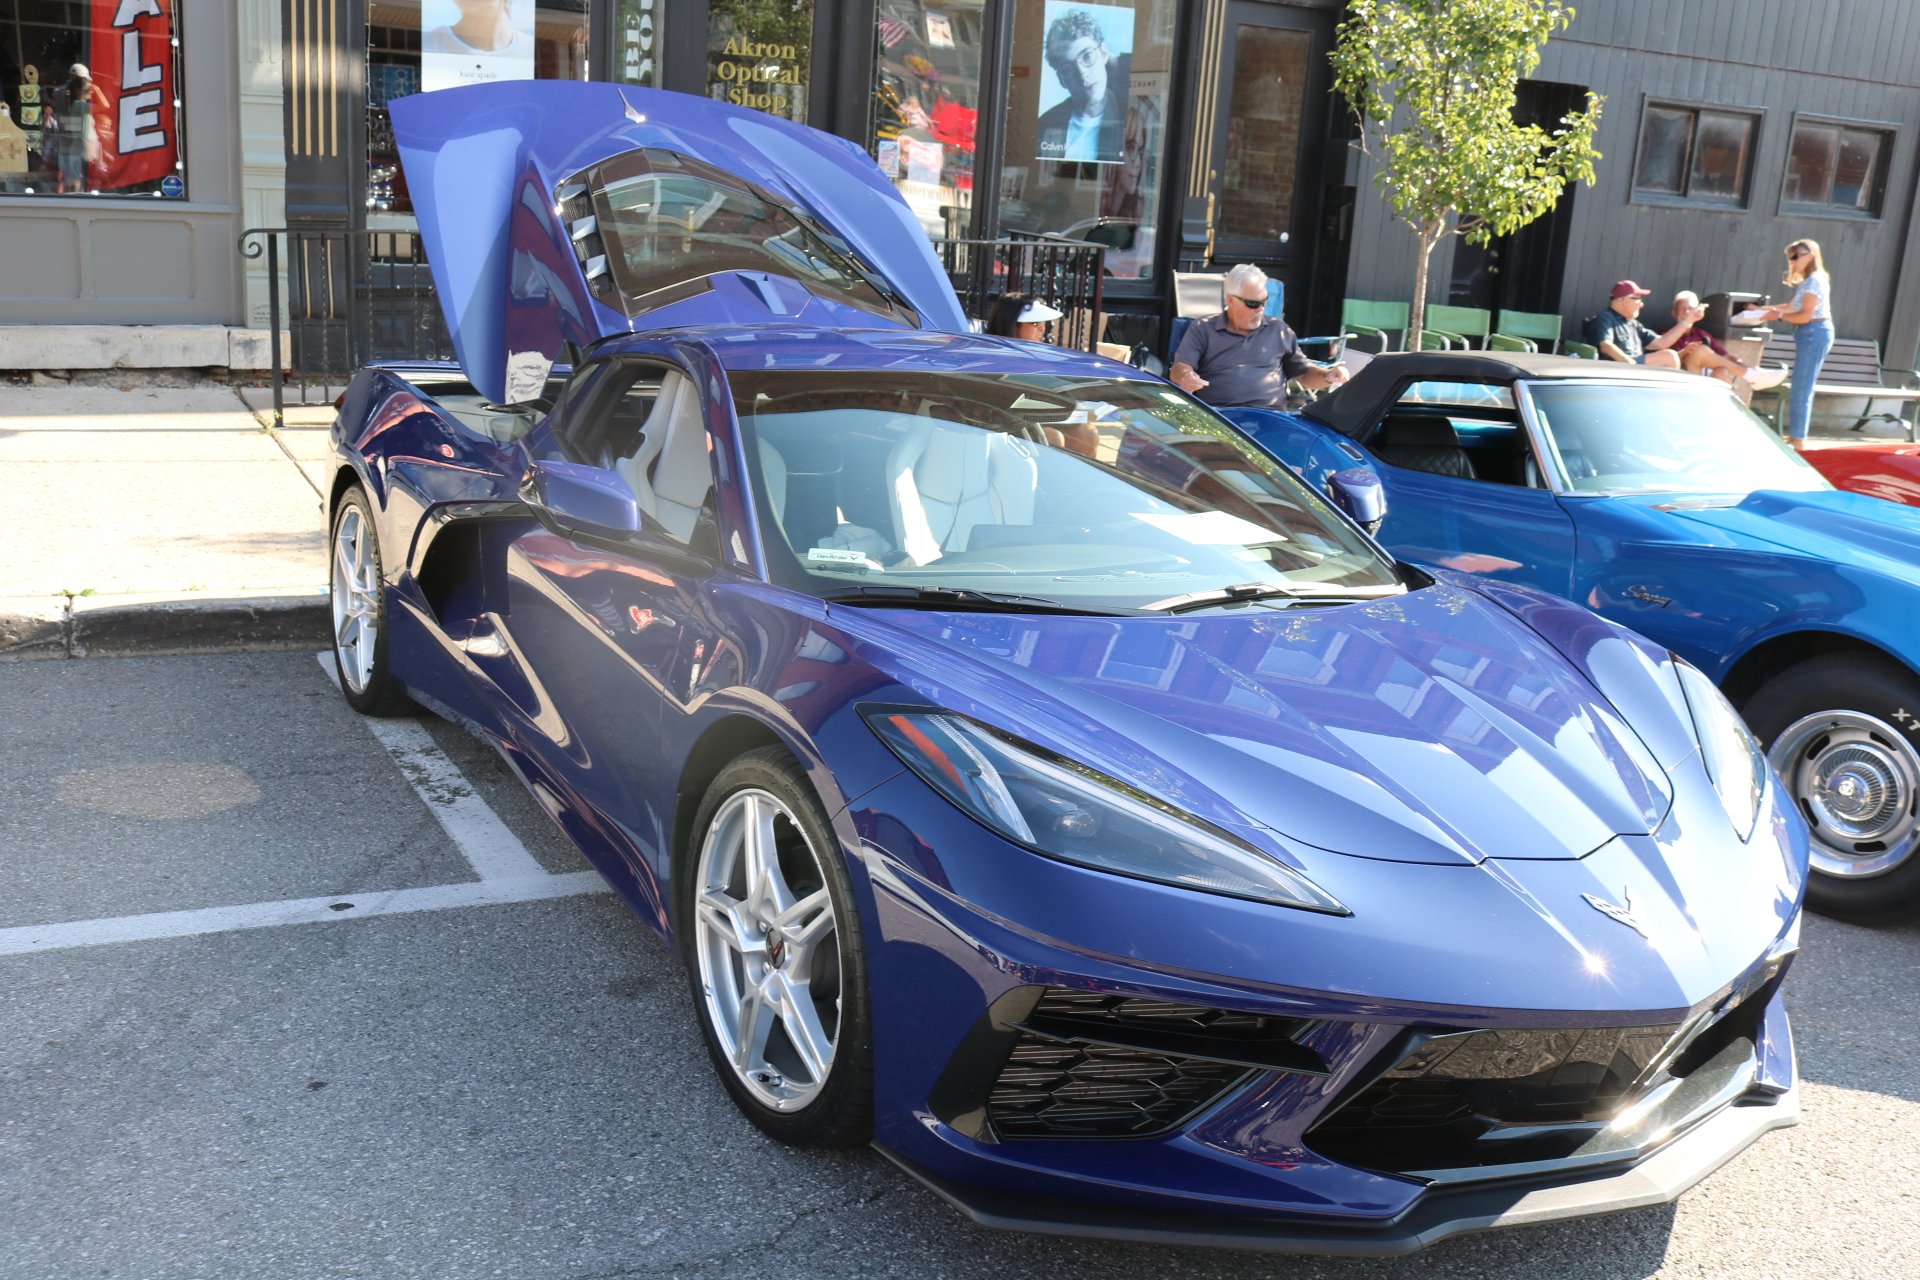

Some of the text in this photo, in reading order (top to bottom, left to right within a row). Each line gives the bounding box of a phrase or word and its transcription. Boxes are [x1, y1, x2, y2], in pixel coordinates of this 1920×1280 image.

[722, 36, 797, 60] Akron
[717, 61, 800, 86] Optical
[729, 88, 787, 115] Shop
[1040, 141, 1064, 151] Calvin
